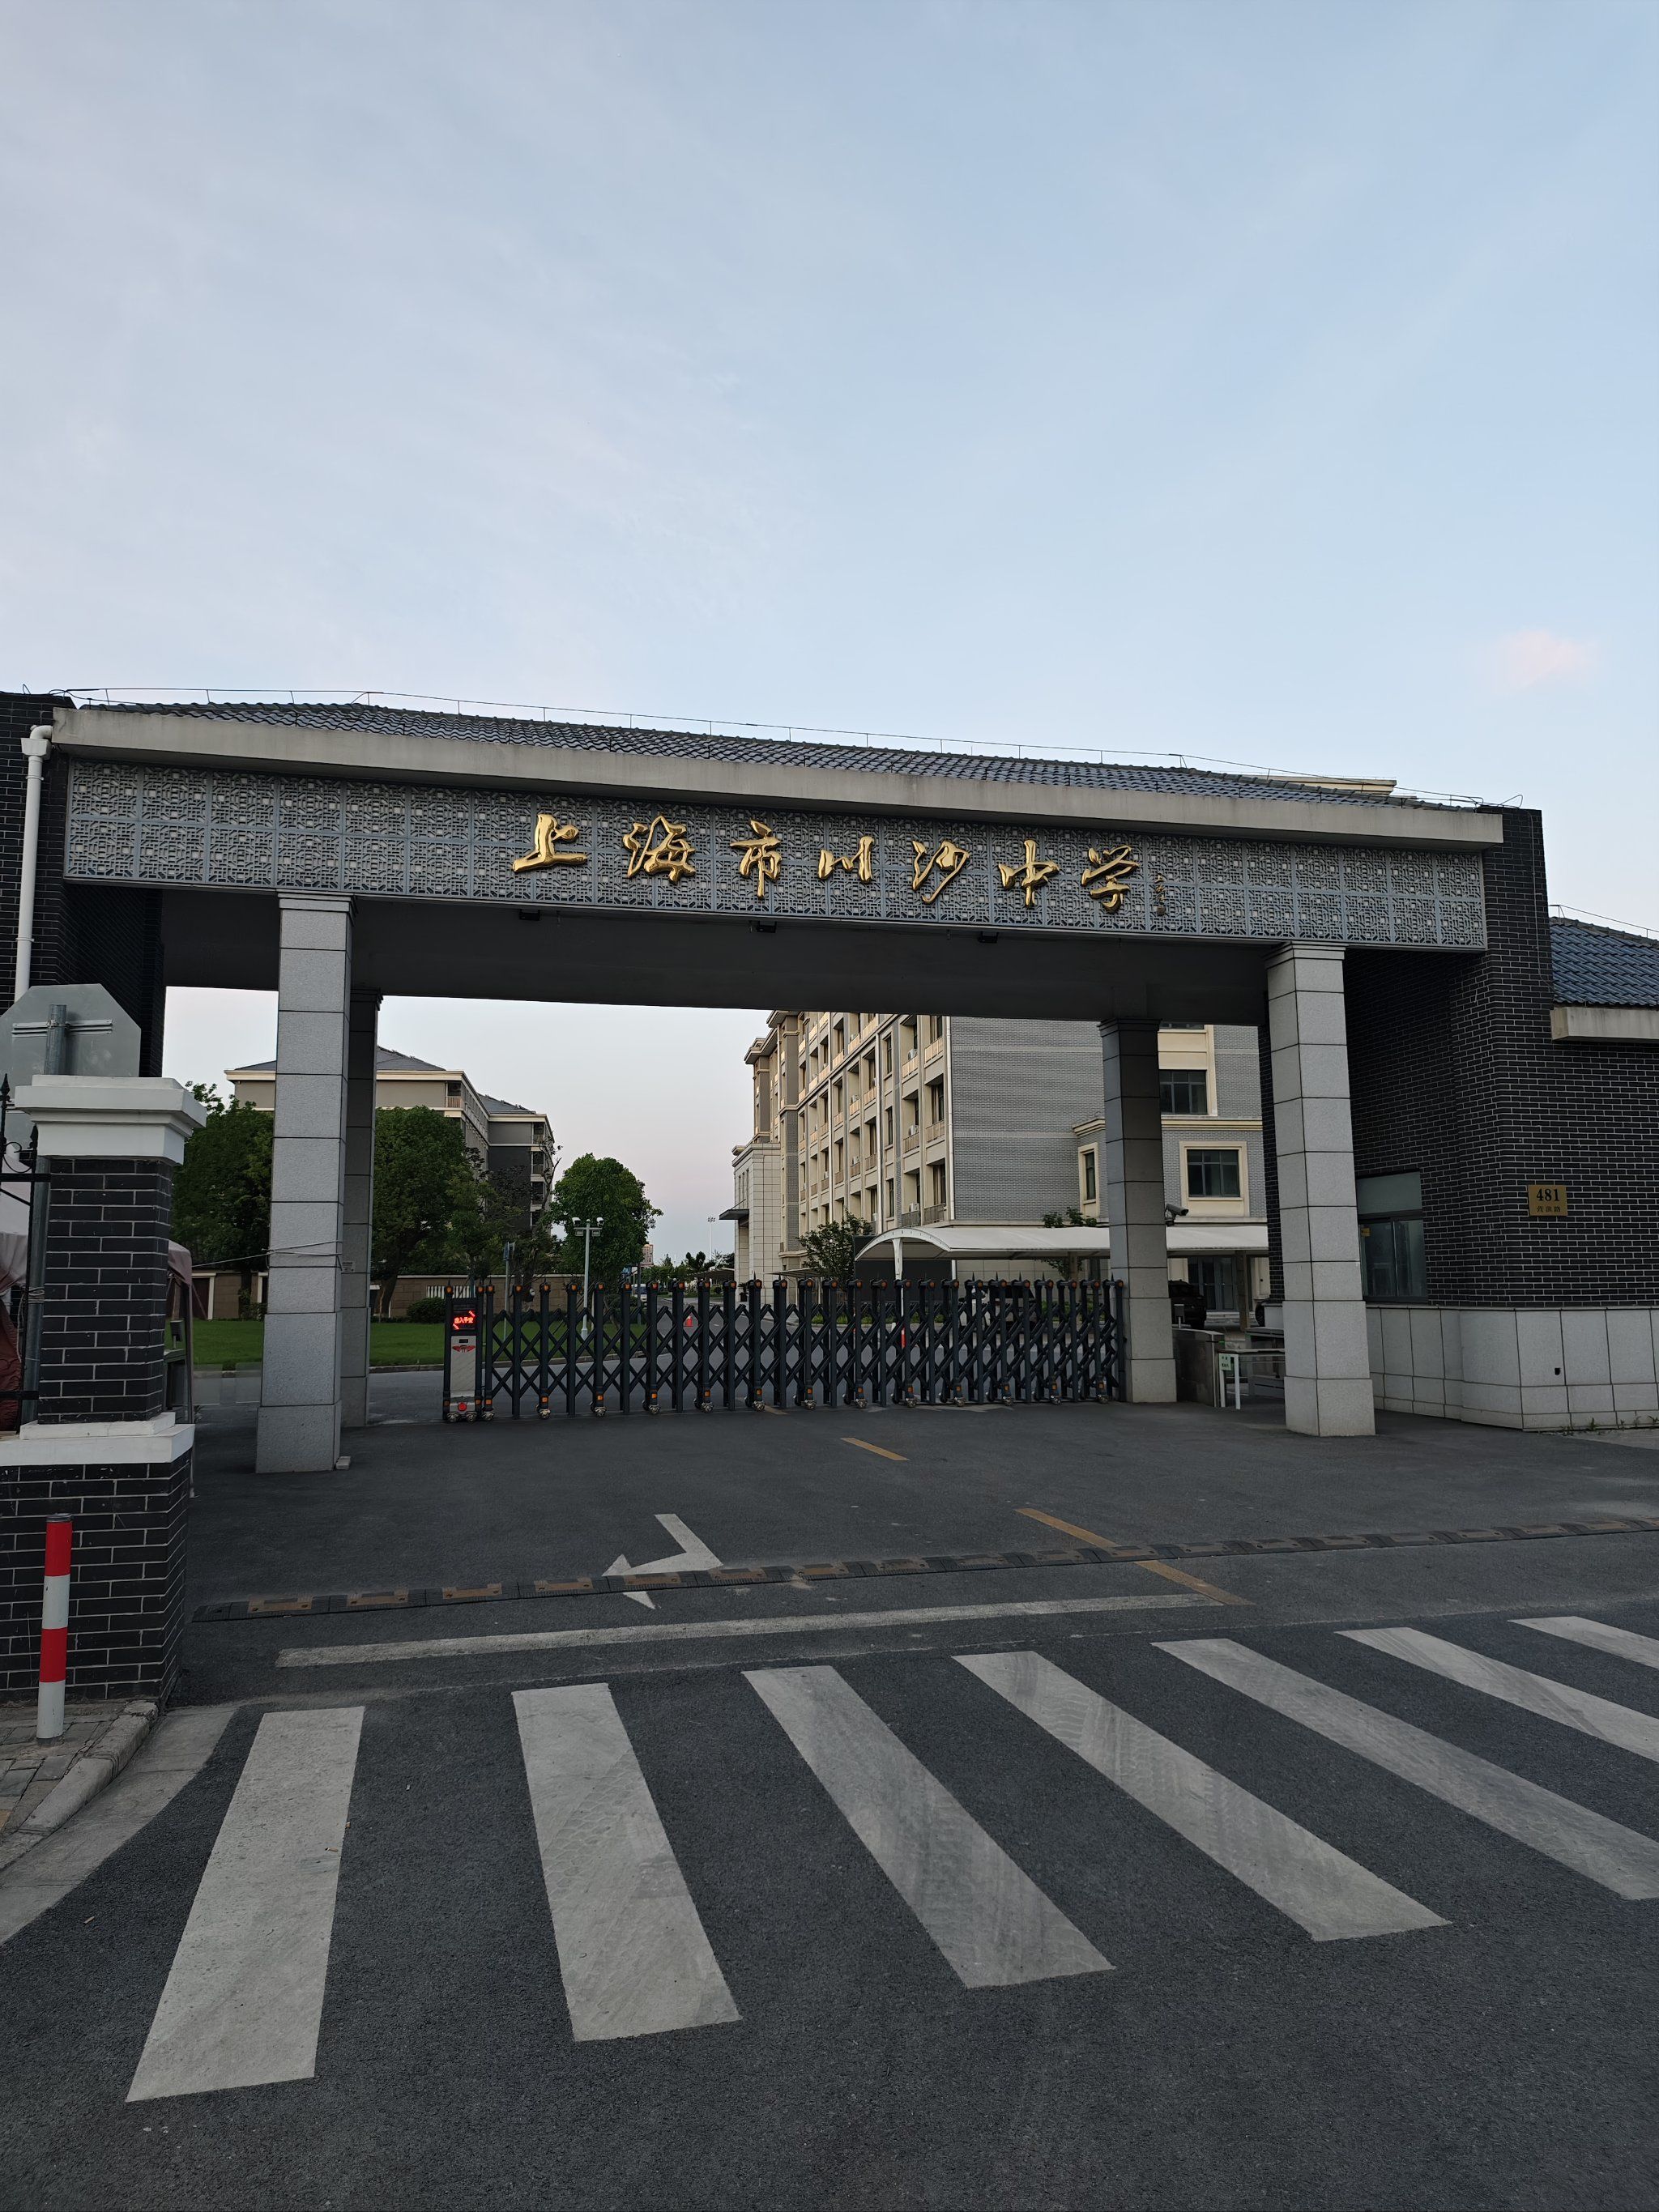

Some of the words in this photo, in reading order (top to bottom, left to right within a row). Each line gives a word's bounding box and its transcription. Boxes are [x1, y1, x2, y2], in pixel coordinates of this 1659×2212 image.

[512, 812, 1140, 913] 上海市川沙中学
[1536, 1188, 1560, 1202] 481
[454, 1315, 474, 1324] 出入平安
